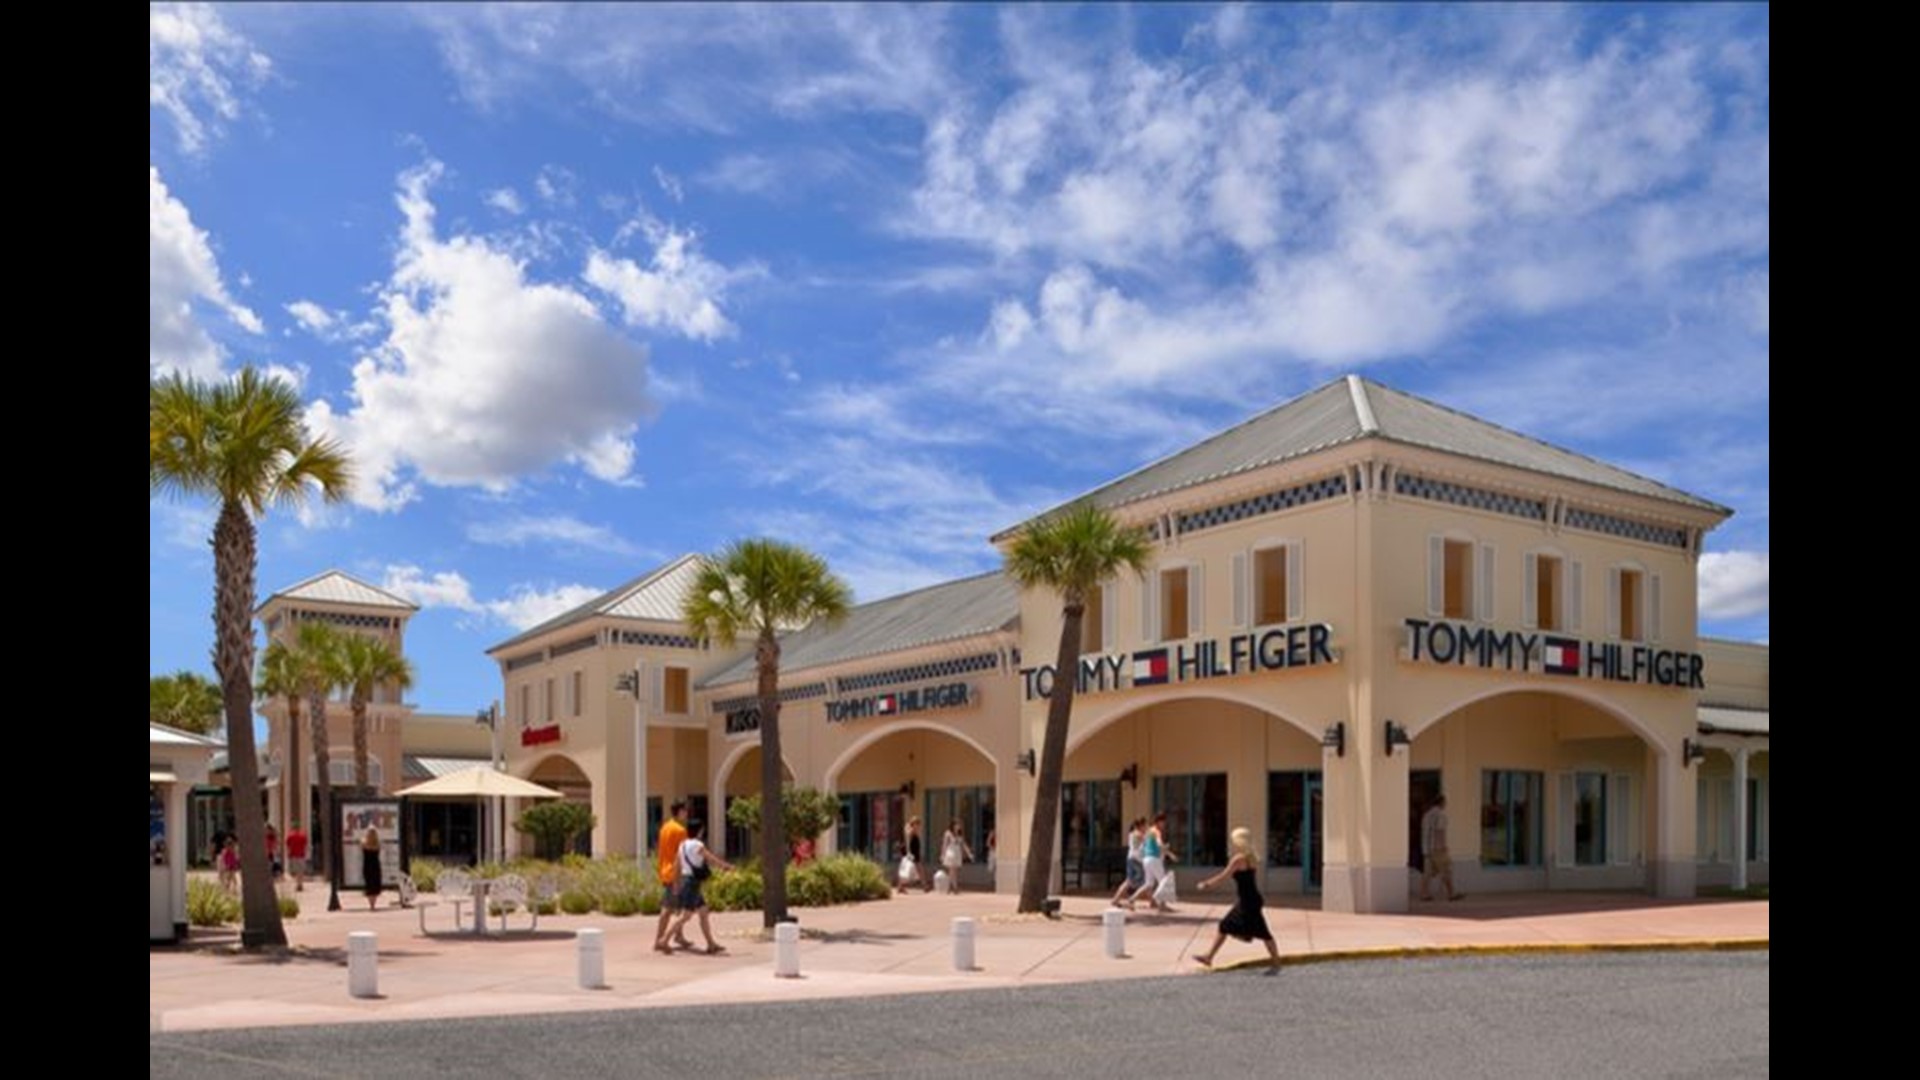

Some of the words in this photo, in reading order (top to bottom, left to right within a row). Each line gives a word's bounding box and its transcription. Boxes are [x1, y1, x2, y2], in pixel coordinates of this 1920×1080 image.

[1177, 624, 1334, 681] HILFIGER
[1405, 618, 1537, 671] TOMMY
[1588, 642, 1704, 689] HILFIGER
[824, 696, 876, 722] TOMMY
[899, 683, 969, 713] HILFIGER
